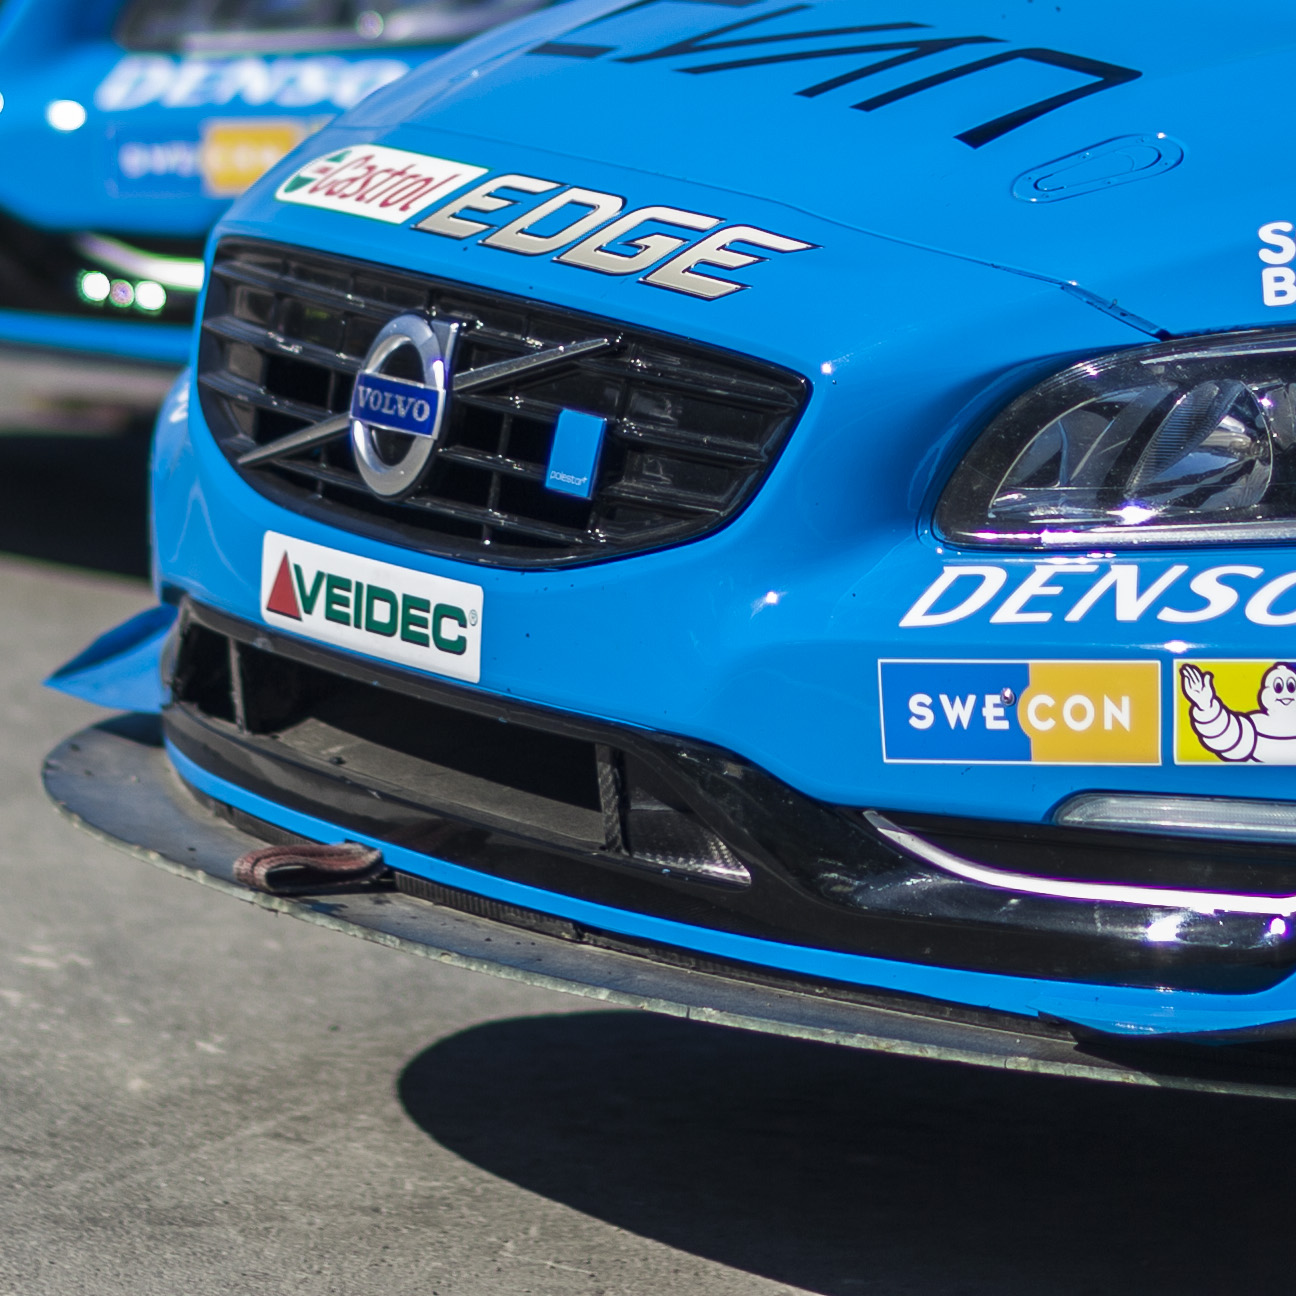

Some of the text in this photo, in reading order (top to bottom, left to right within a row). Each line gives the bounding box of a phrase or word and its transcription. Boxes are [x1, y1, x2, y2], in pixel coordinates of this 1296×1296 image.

[307, 154, 462, 212] Castrol
[411, 171, 823, 301] EDGE
[357, 385, 431, 422] VOLVO
[549, 470, 586, 486] polestar
[293, 562, 468, 656] VEIDEC
